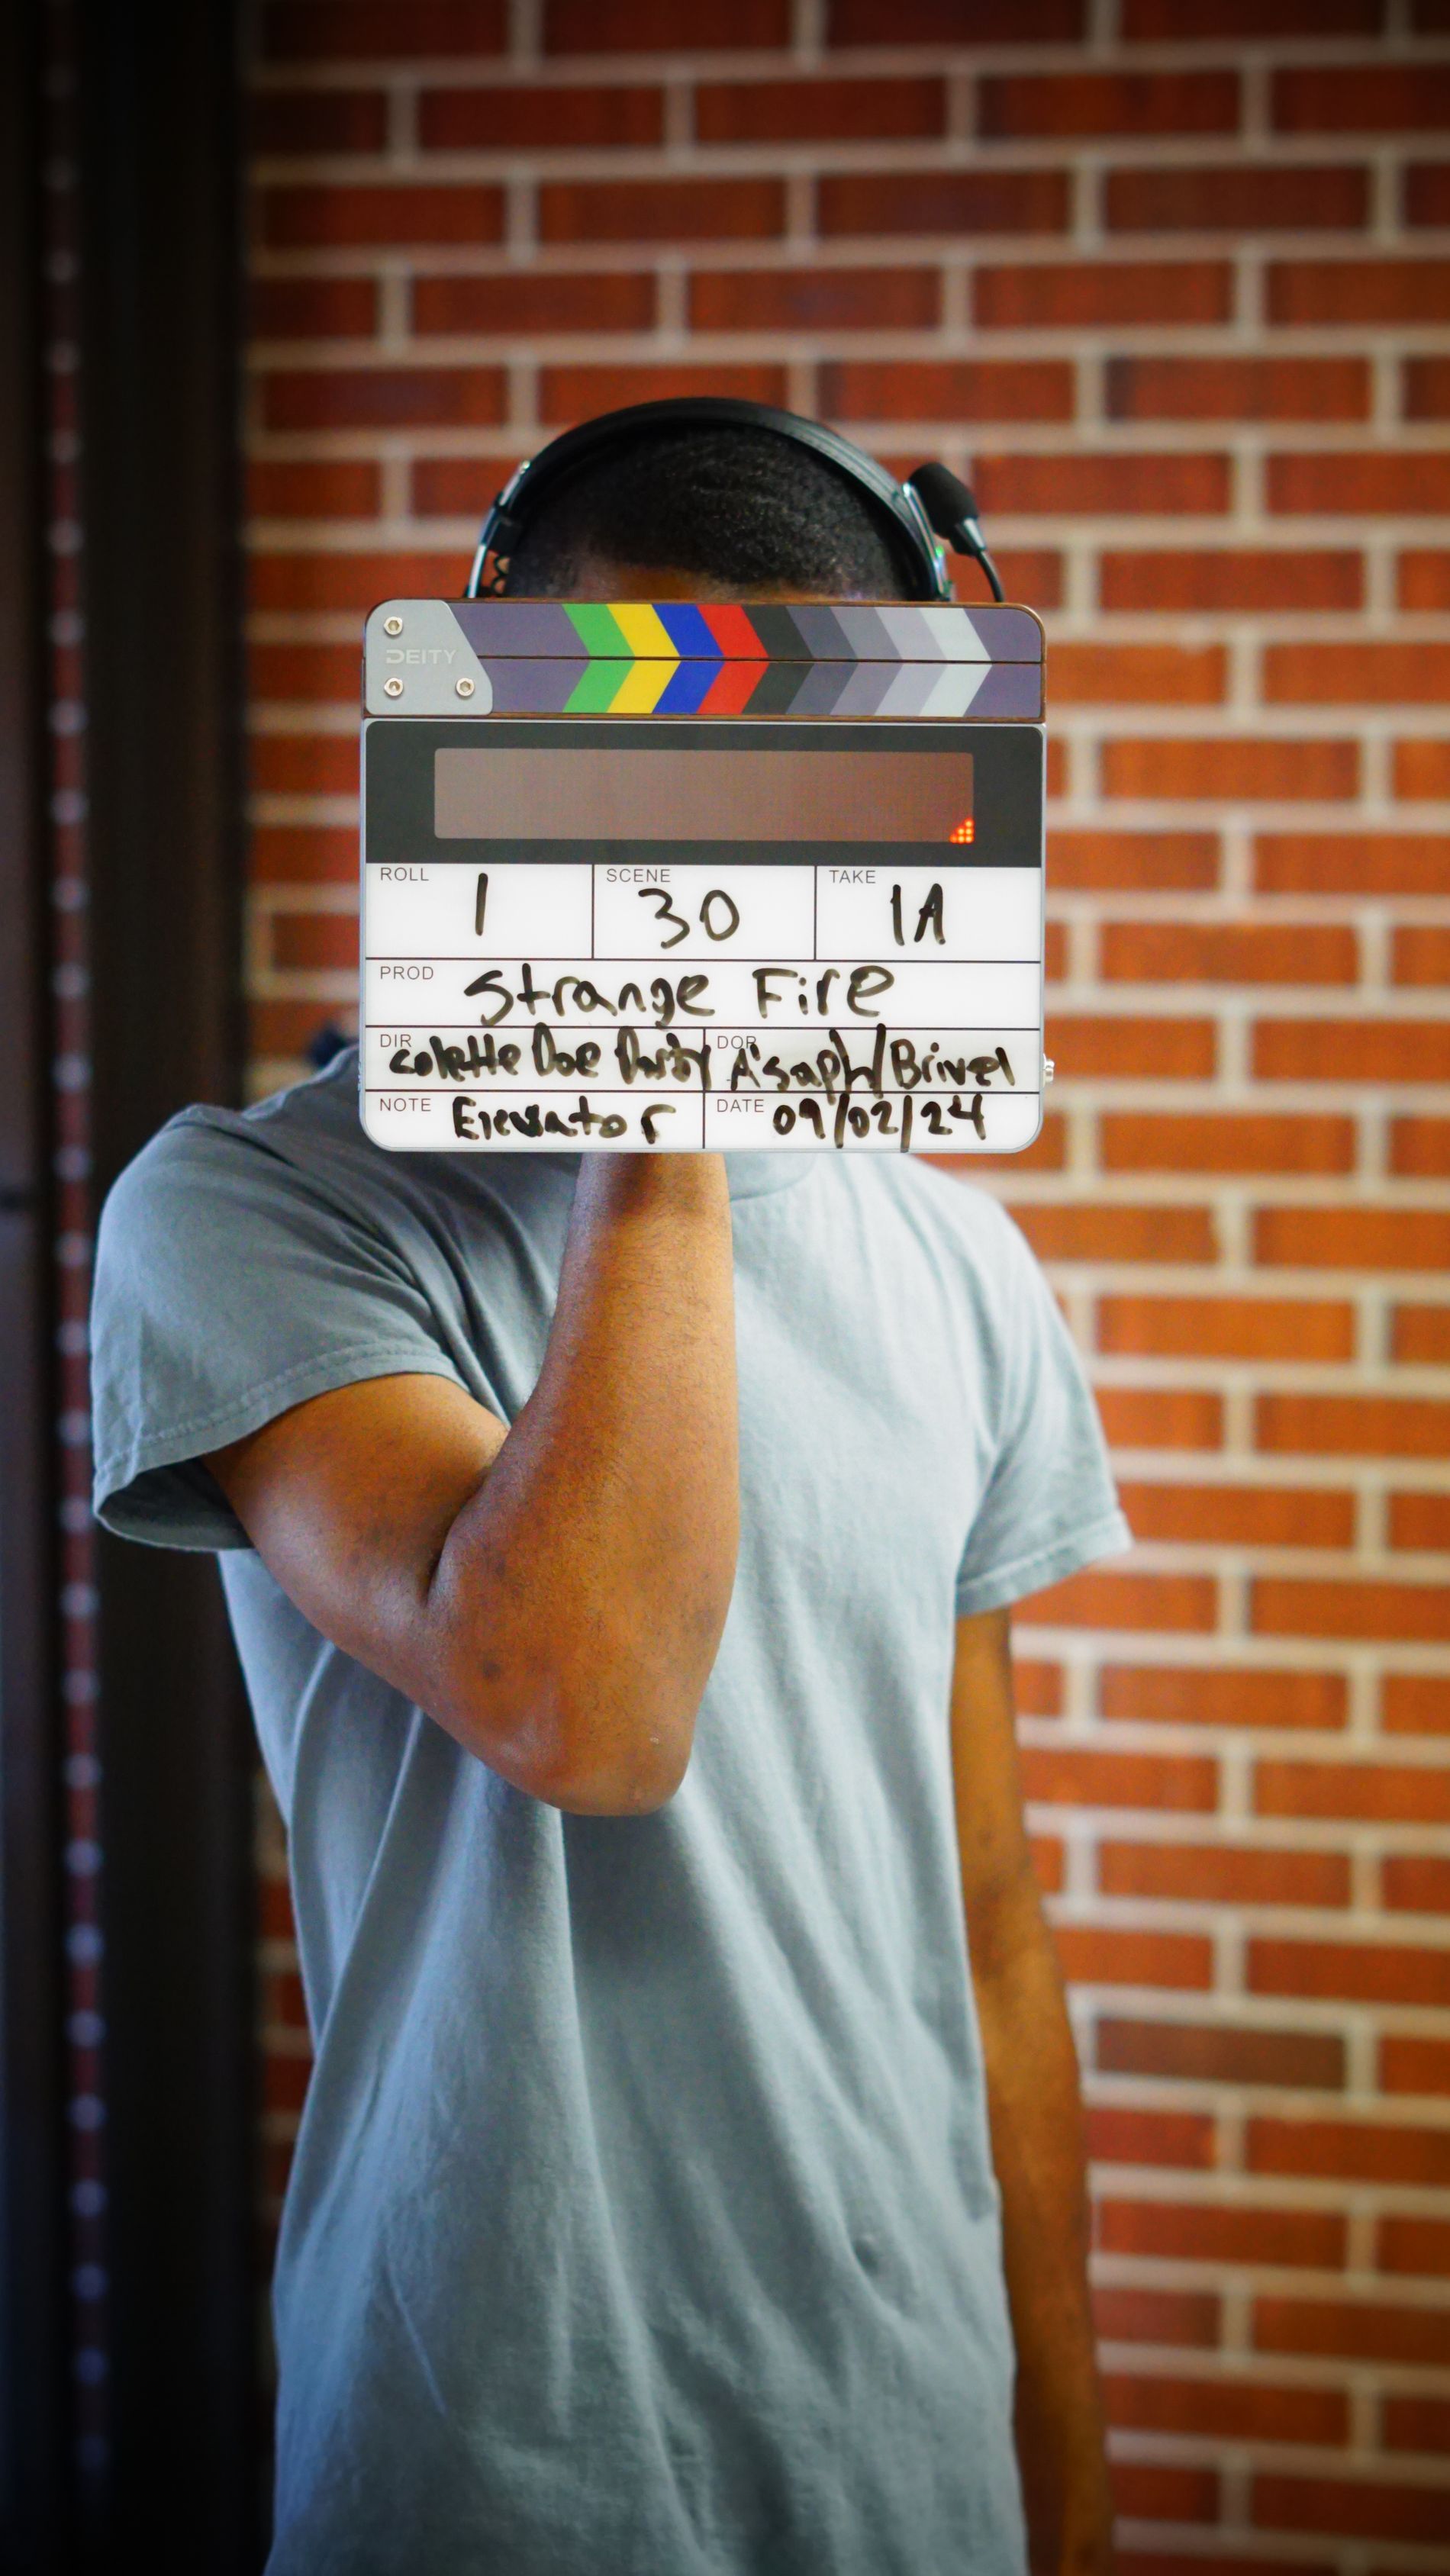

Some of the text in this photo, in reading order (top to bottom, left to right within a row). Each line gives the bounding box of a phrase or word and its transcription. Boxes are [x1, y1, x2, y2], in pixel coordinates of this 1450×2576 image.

[385, 649, 457, 665] DEITY
[381, 867, 430, 882] ROLL
[606, 868, 672, 883] SCENE
[828, 870, 877, 884] TAKE
[638, 887, 740, 949] 30
[891, 883, 946, 946] 1A
[380, 966, 434, 980] PROD
[463, 962, 896, 1029] Strange Fire
[380, 1034, 413, 1048] DIR
[380, 1098, 432, 1112] NOTE
[717, 1099, 765, 1113] DATE
[773, 1092, 988, 1153] 09/02/24
